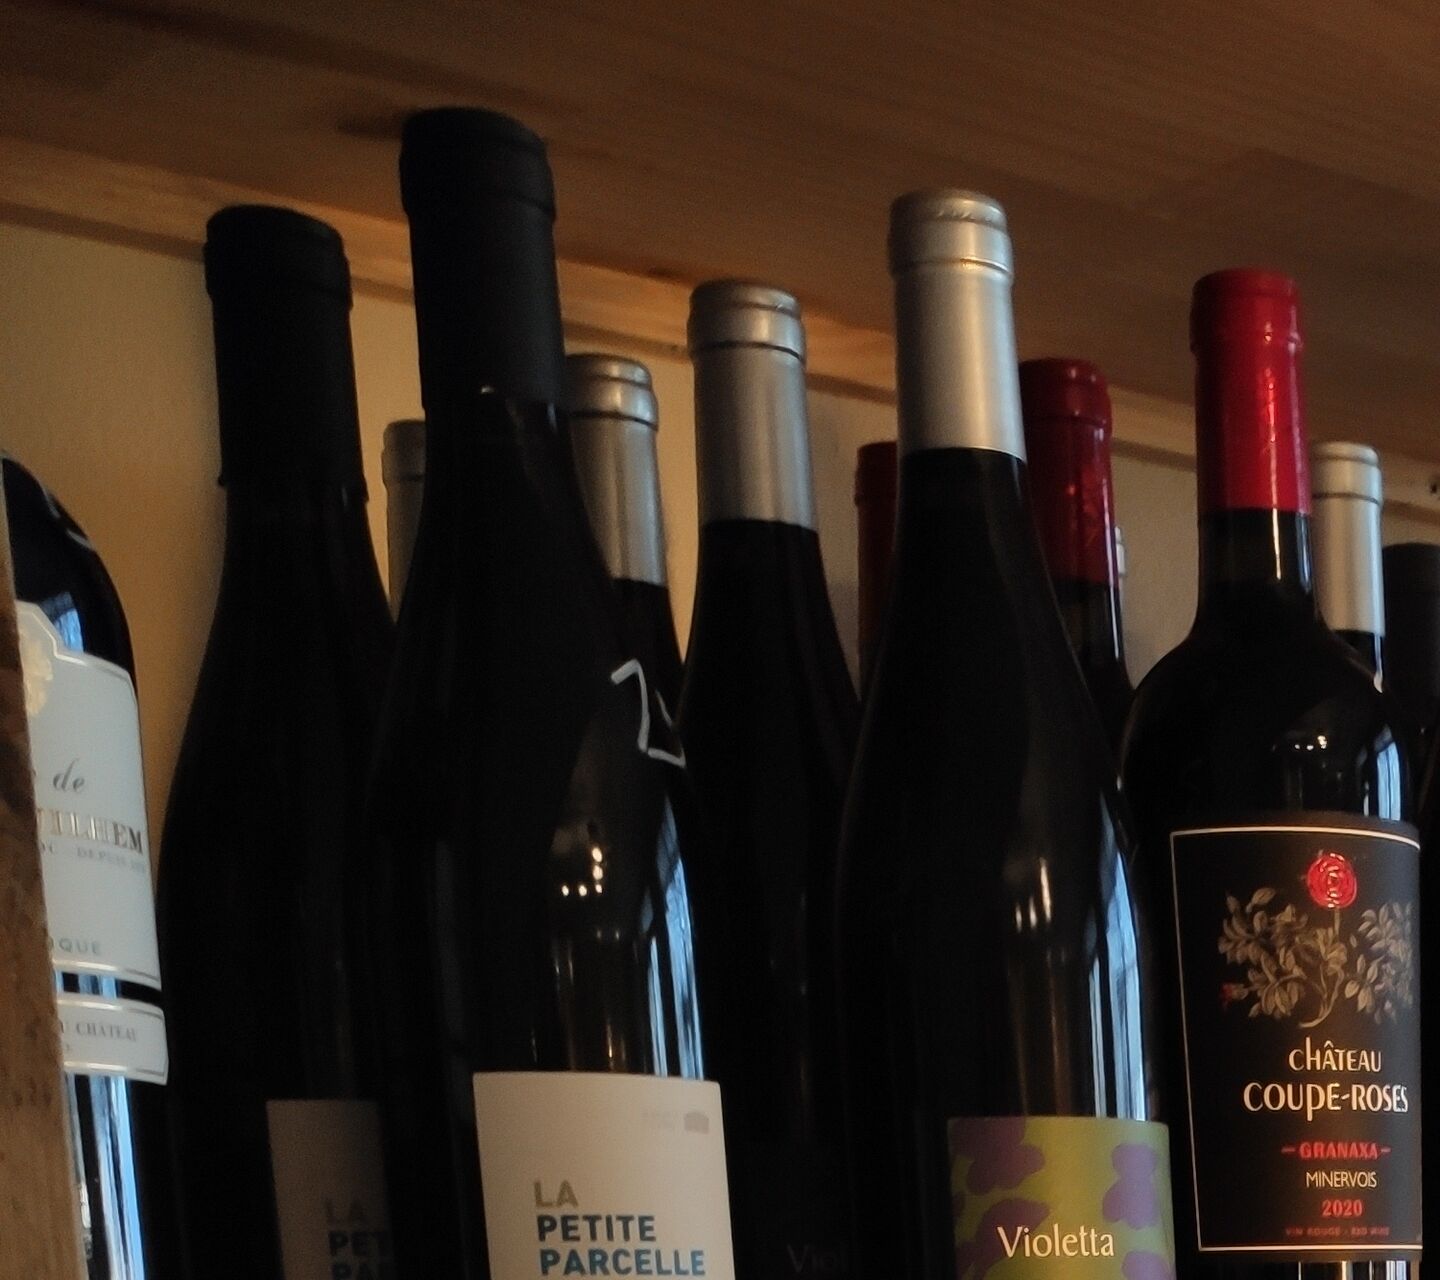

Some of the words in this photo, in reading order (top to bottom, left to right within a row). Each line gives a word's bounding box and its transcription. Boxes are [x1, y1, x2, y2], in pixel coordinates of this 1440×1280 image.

[1243, 1082, 1409, 1121] COUPE-ROSES
[1299, 1142, 1379, 1160] GRANAXA
[534, 1179, 579, 1208] LA
[1305, 1171, 1378, 1189] MINERVOIS
[1321, 1199, 1363, 1218] 2020
[537, 1215, 657, 1242] PETITE
[996, 1223, 1115, 1259] Violetta
[540, 1249, 706, 1277] PARCELLE
